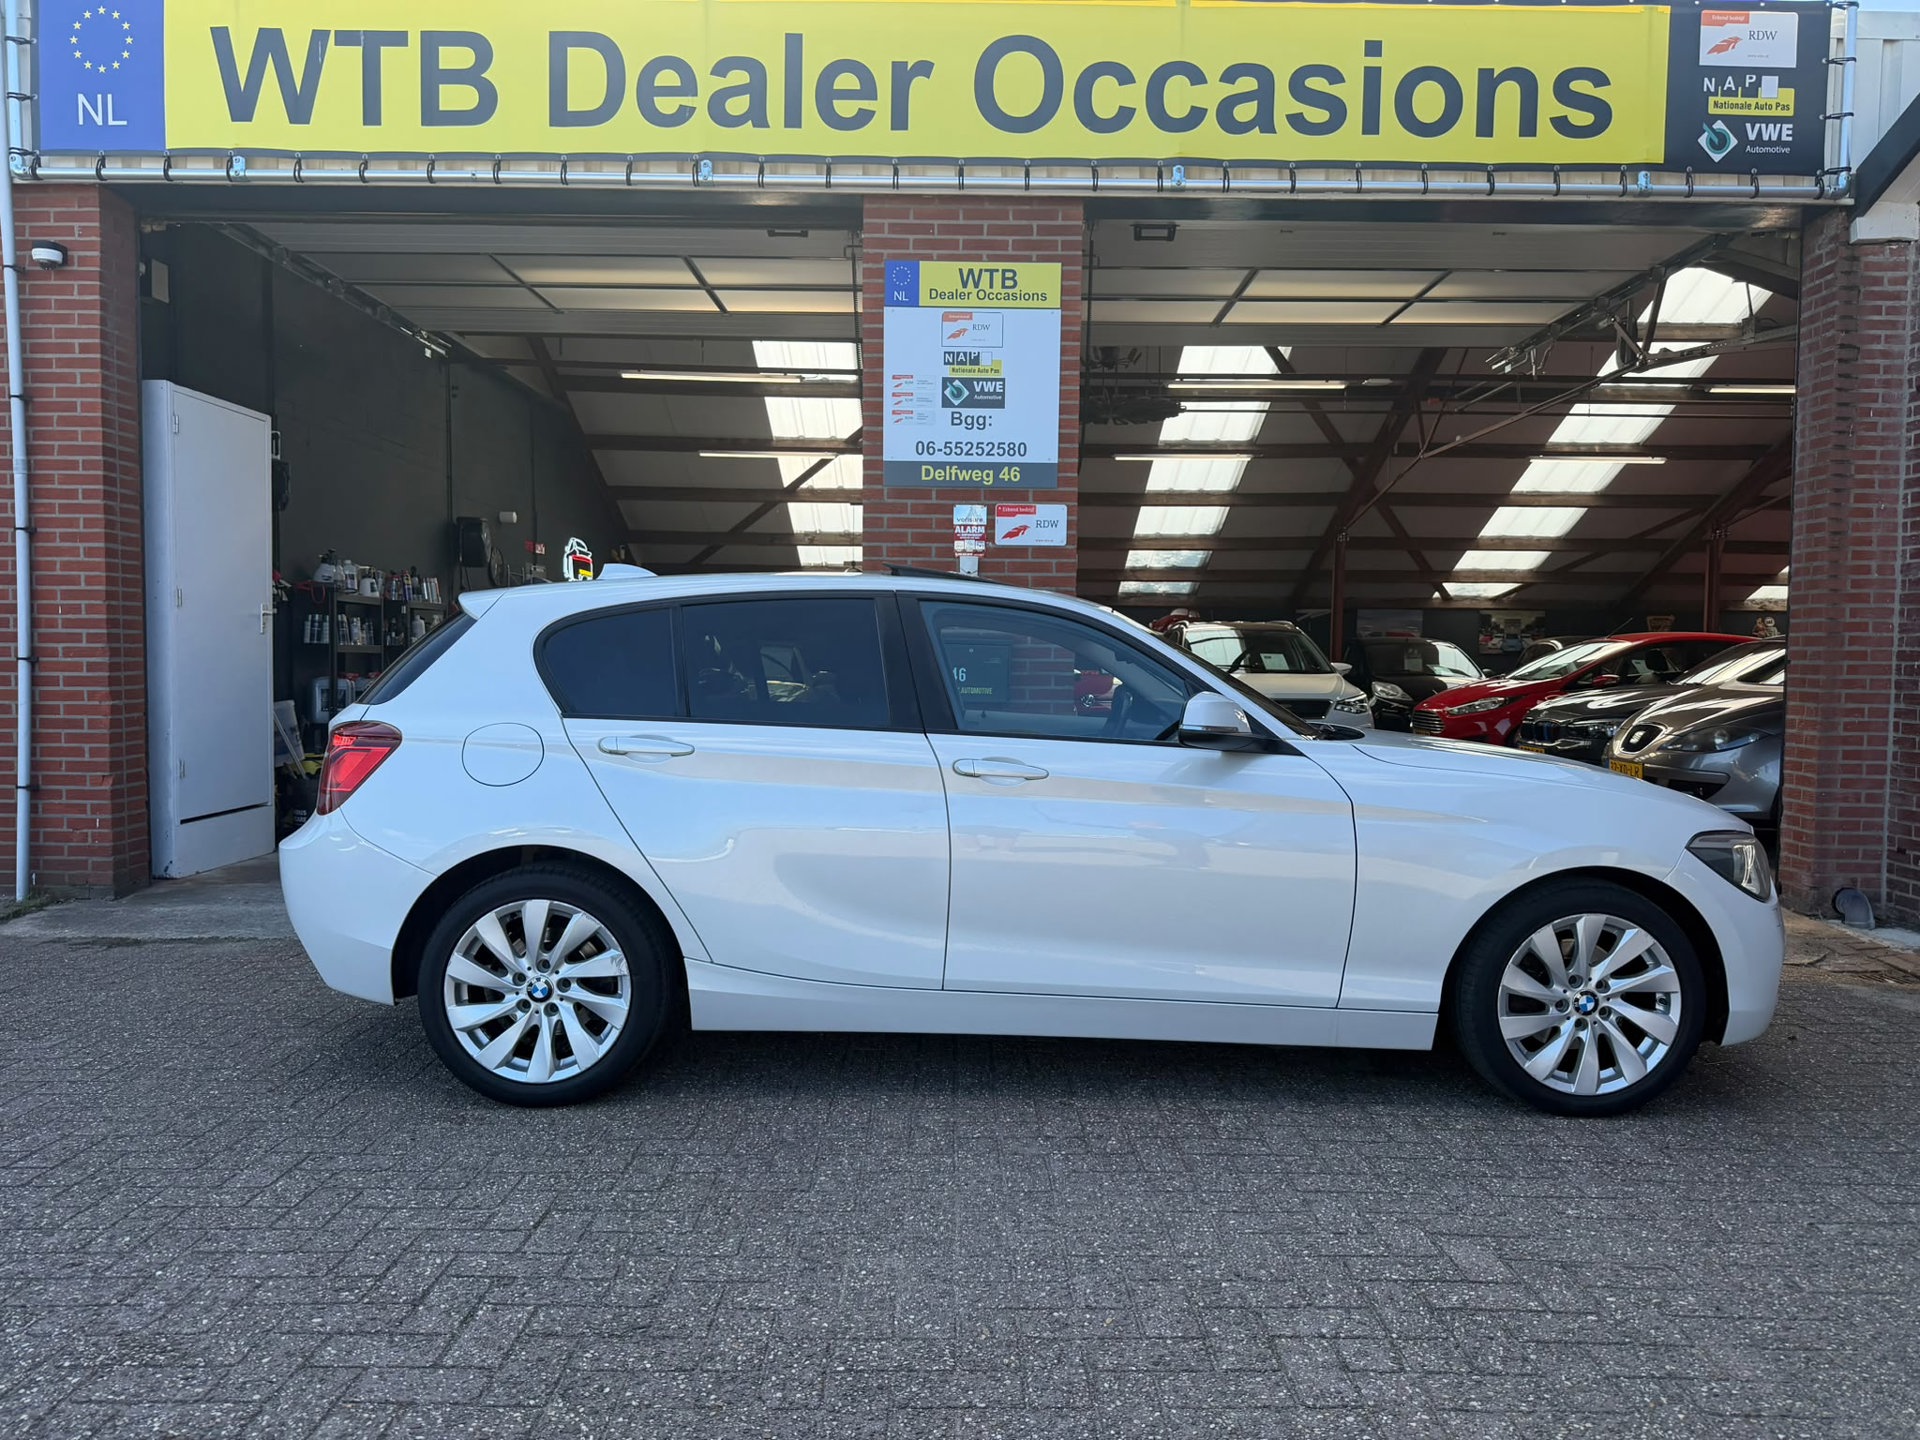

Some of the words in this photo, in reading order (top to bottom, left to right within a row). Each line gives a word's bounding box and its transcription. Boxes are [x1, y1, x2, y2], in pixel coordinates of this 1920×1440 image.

[1748, 30, 1778, 41] RDW
[210, 26, 498, 127] WTB
[549, 31, 934, 131] Dealer
[974, 34, 1612, 139] Occasions
[77, 93, 127, 126] NL
[1713, 100, 1752, 111] Nationale
[1754, 101, 1773, 111] Auto
[1775, 102, 1790, 111] Pas
[1745, 123, 1793, 142] VWE
[1745, 145, 1790, 154] Automotive
[958, 268, 1018, 290] WTB
[893, 291, 909, 301] NL
[929, 288, 972, 301] Dealer
[976, 289, 1048, 302] Occasions
[972, 323, 991, 331] RDW
[951, 366, 976, 374] Nationale
[973, 381, 1004, 393] VWE
[951, 411, 993, 431] Bgg:
[915, 440, 1028, 457] 06-55252580
[921, 465, 994, 485] Delfweg
[999, 466, 1021, 482] 46
[954, 525, 985, 534] ALARM
[1035, 519, 1060, 529] RDW
